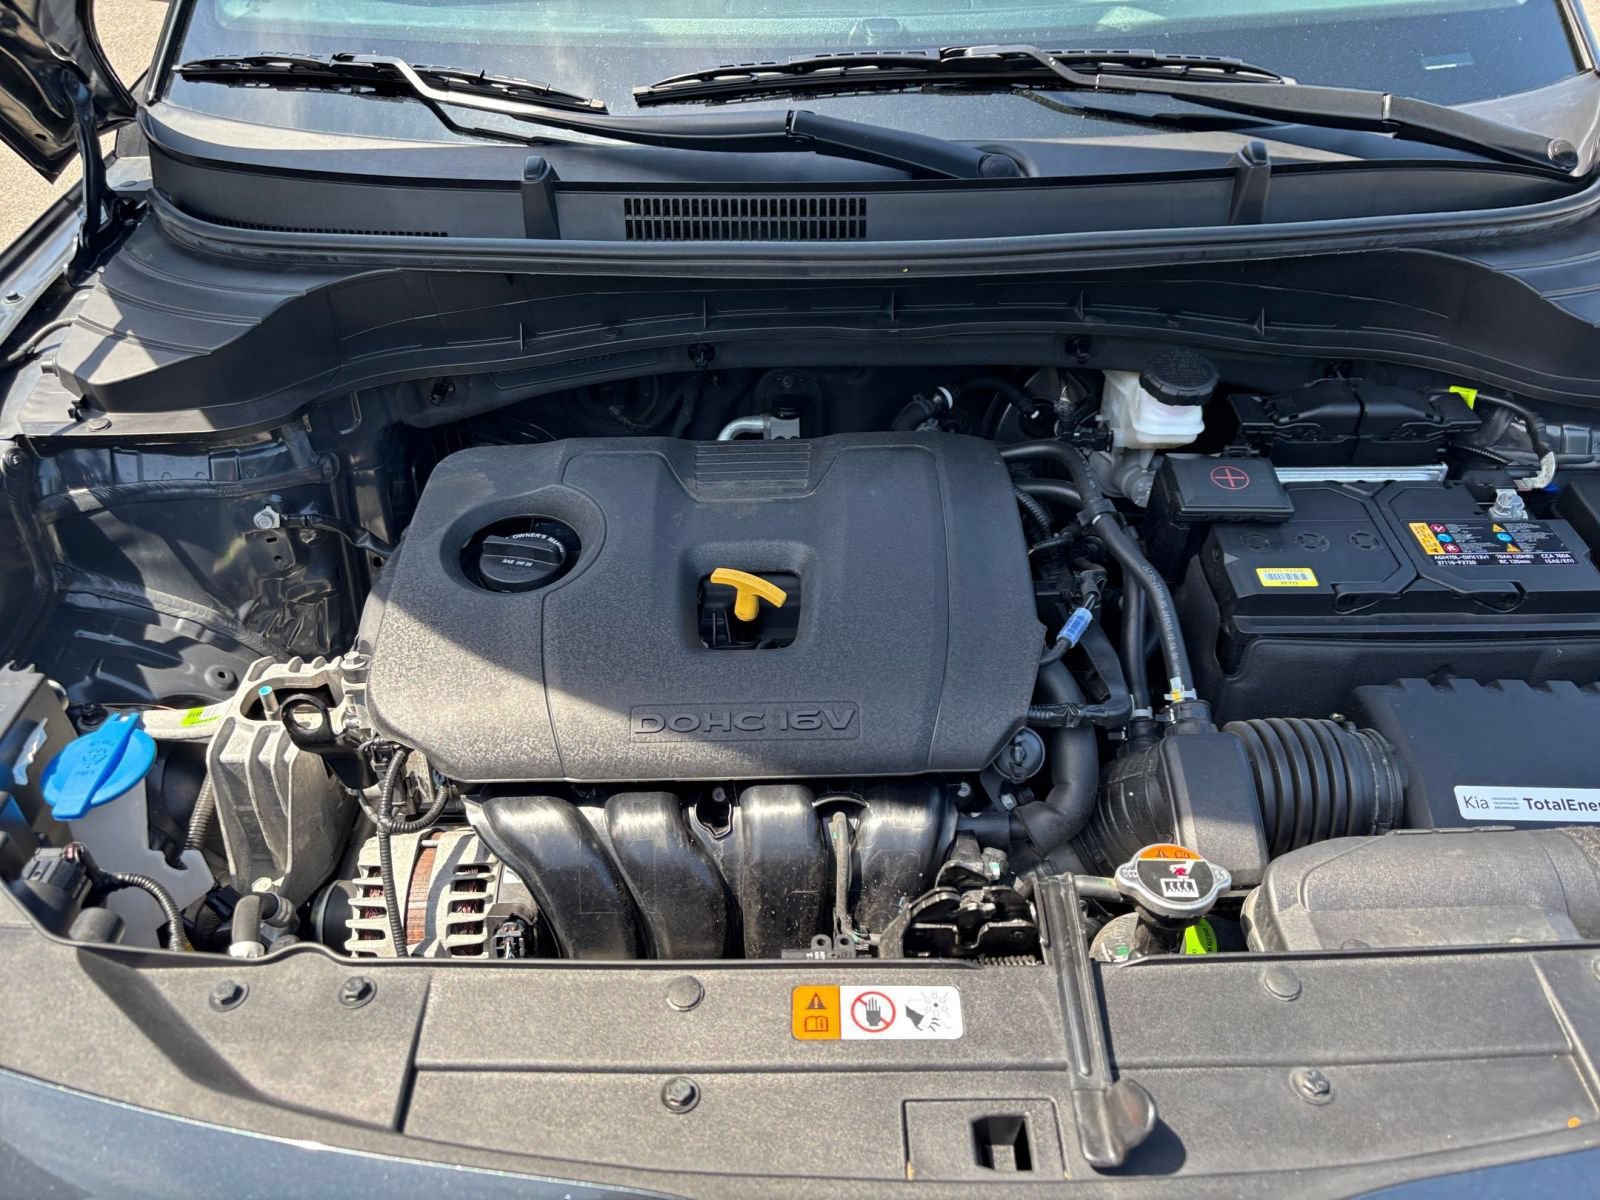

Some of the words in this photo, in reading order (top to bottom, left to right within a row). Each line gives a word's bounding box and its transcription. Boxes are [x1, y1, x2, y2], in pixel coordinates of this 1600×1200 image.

[635, 711, 766, 734] DOHC
[779, 709, 856, 731] 16V
[1463, 796, 1490, 809] Kia
